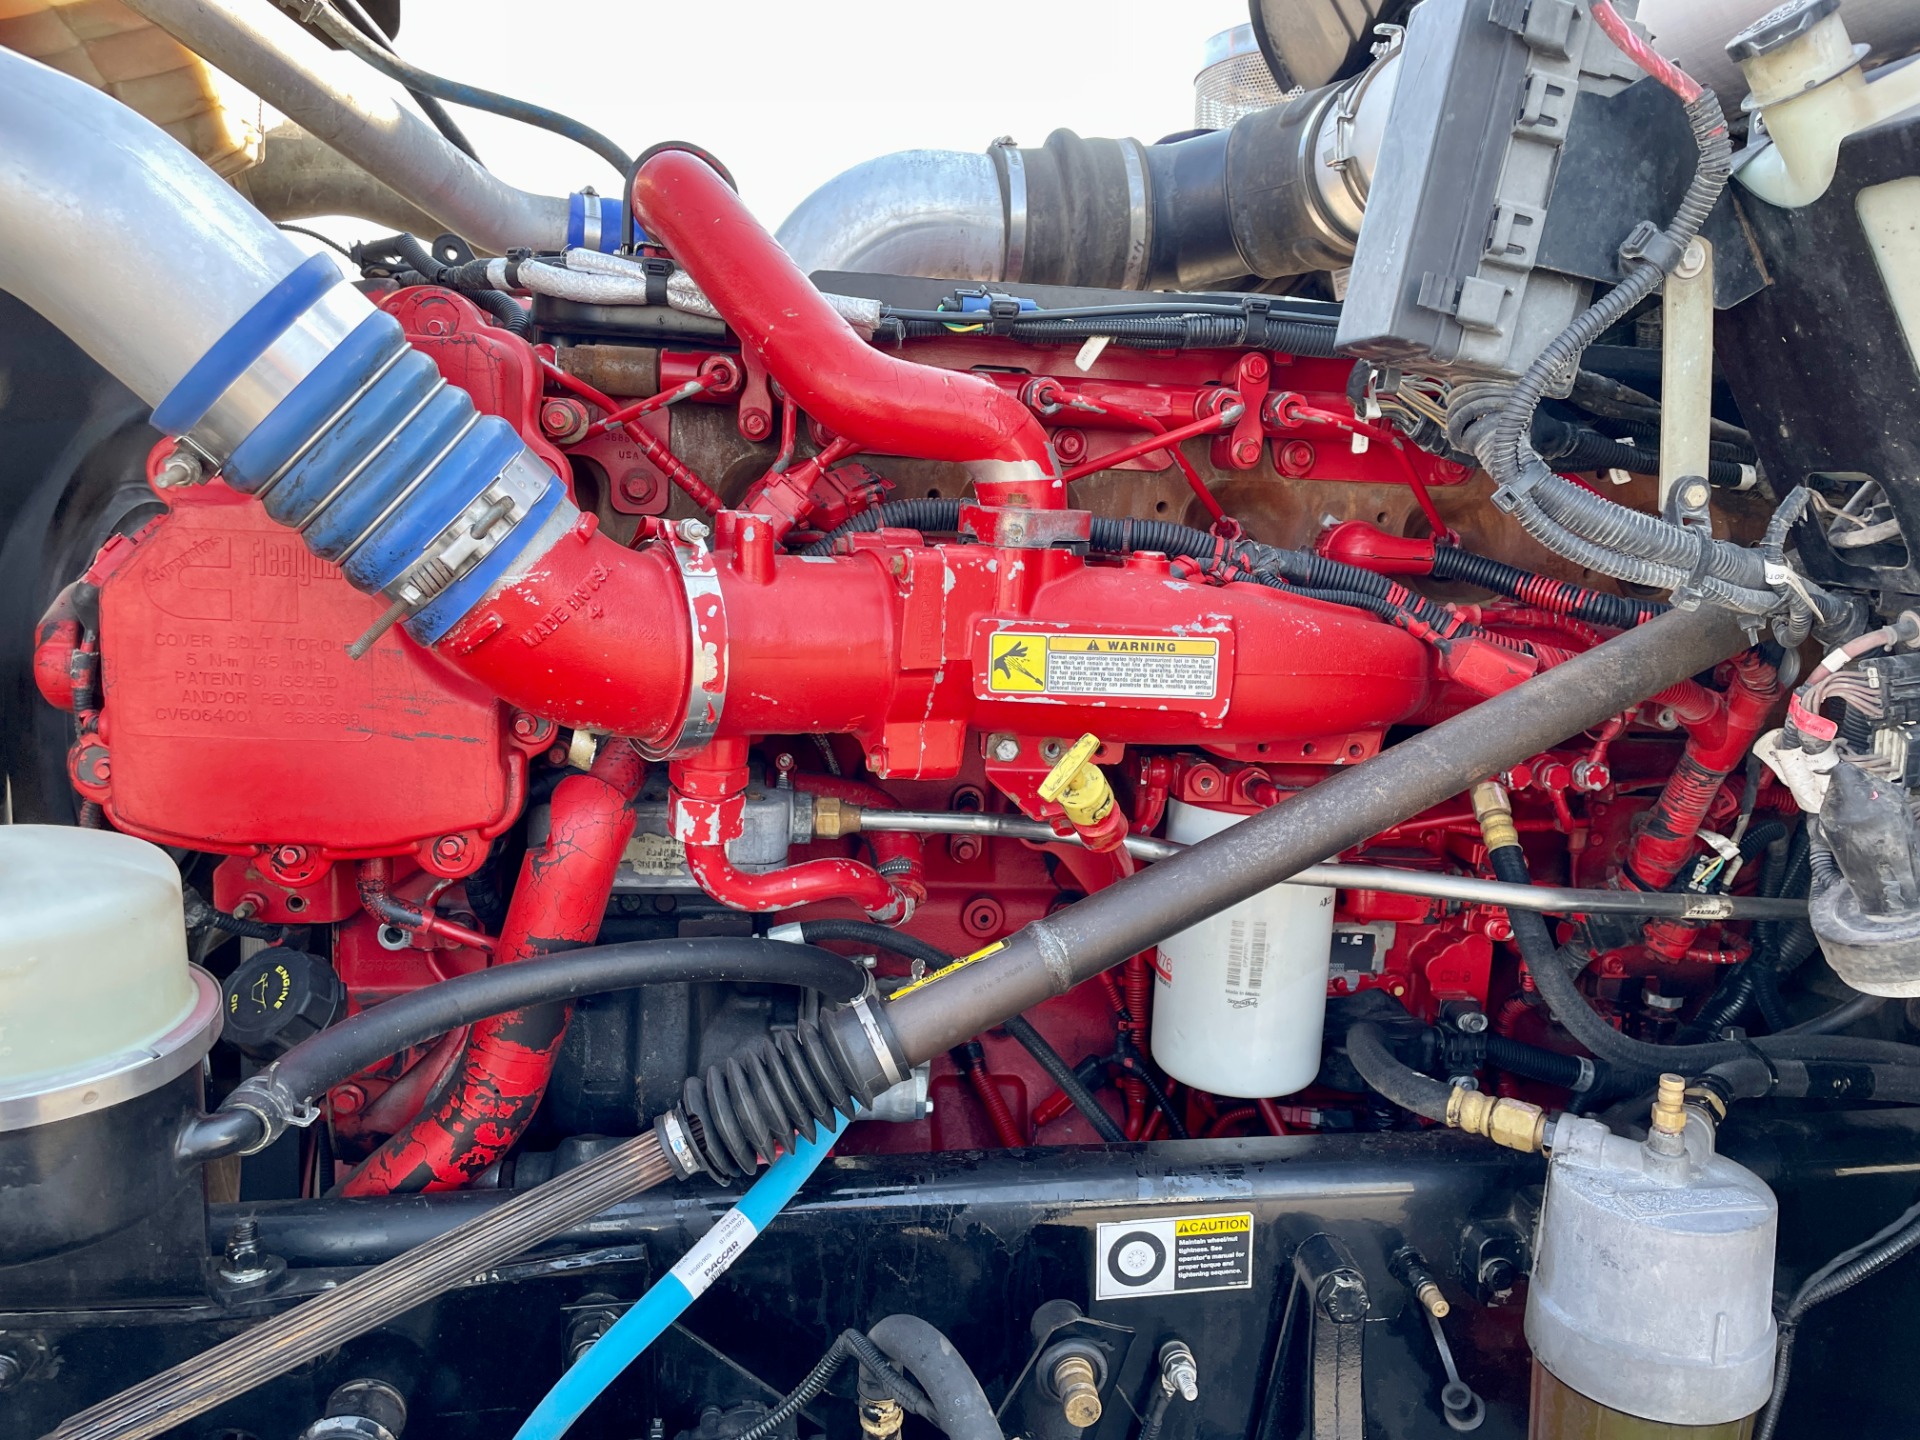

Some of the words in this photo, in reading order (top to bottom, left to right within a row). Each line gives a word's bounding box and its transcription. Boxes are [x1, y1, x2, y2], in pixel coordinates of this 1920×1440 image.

[619, 450, 639, 460] USA
[520, 604, 570, 647] MADE
[565, 584, 591, 611] IN
[154, 632, 213, 647] COVER
[227, 636, 273, 651] BOLT
[1107, 641, 1176, 652] WARNING
[186, 652, 197, 666] 5
[279, 674, 339, 689] ISSUED
[262, 692, 336, 707] PENDING
[273, 965, 291, 1010] ENGINE
[230, 993, 239, 1013] OIL
[1189, 1219, 1248, 1232] CAUTION
[1207, 1235, 1237, 1243] wheel/nut
[1178, 1246, 1208, 1254] tightness.
[703, 1240, 739, 1277] PACCAR
[1178, 1254, 1210, 1262] operator's
[1177, 1270, 1208, 1279] tightening
[1210, 1268, 1241, 1276] sequence.
